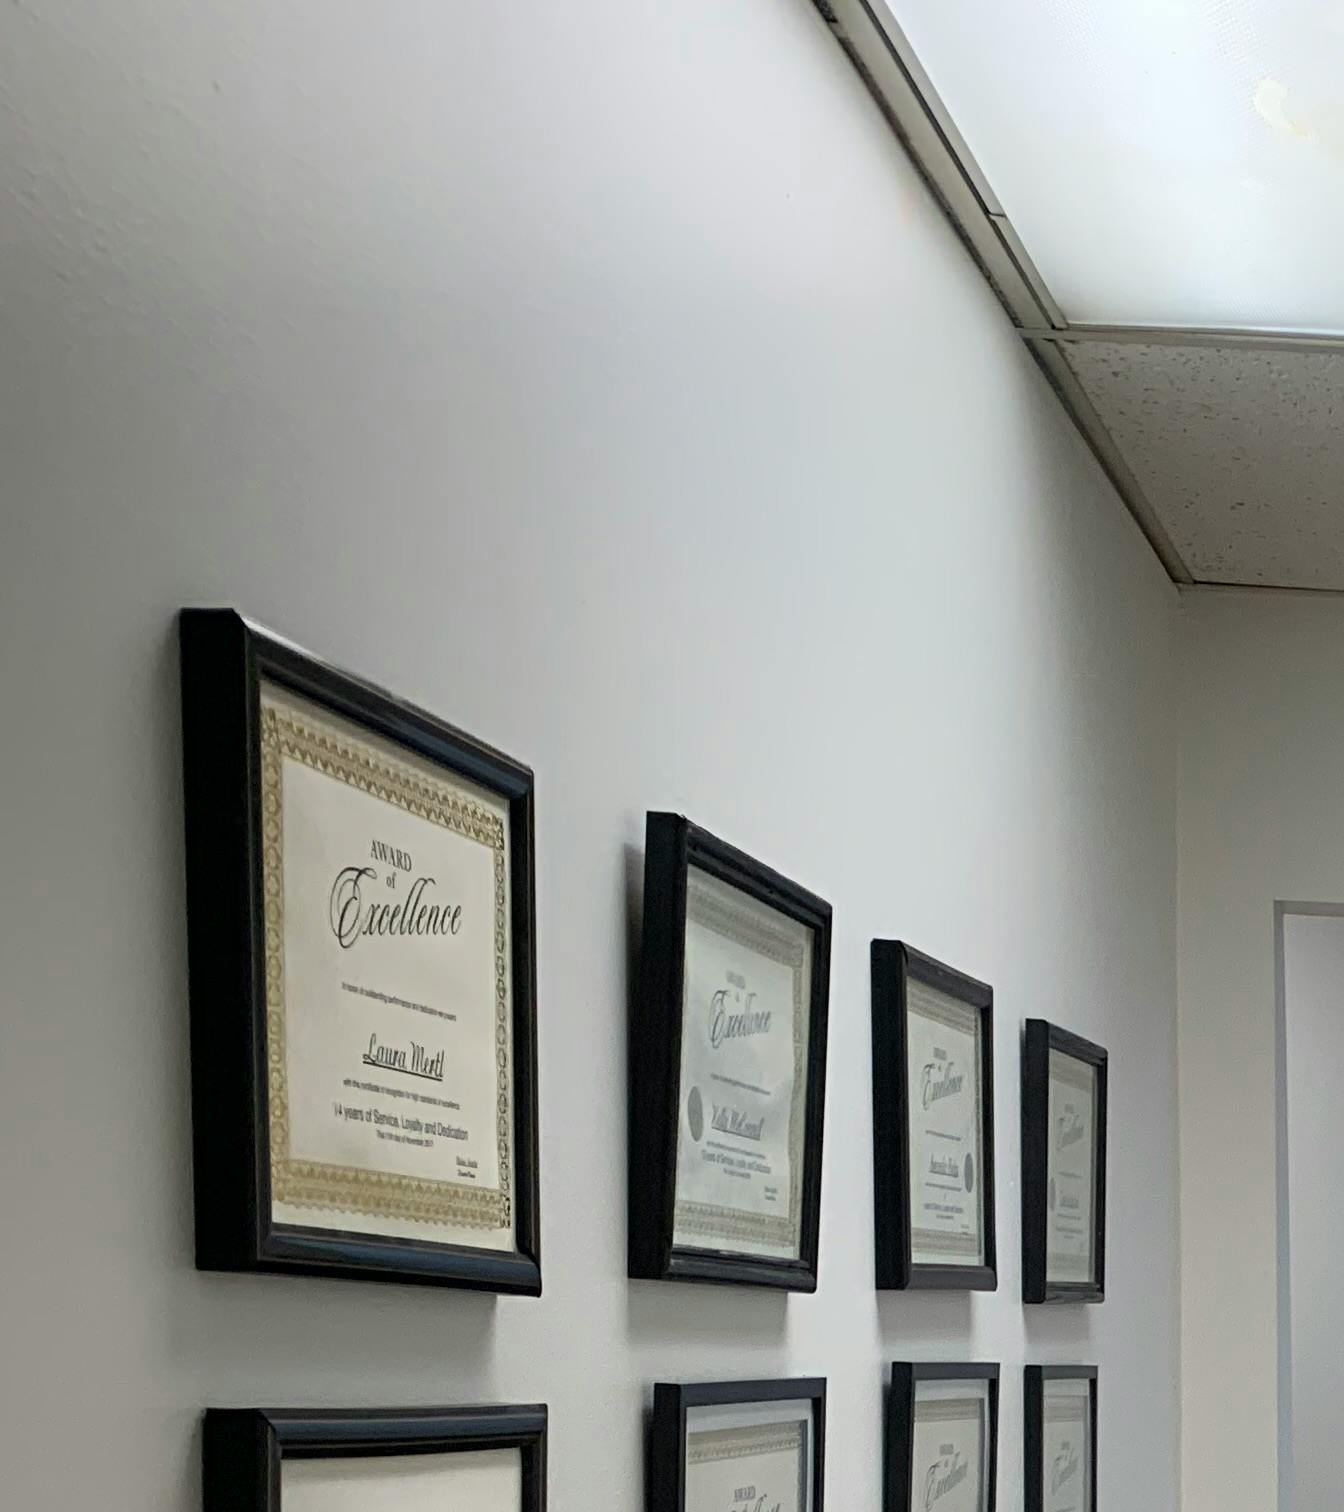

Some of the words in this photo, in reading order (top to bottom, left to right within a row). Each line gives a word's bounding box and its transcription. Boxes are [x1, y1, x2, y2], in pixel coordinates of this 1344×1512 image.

[371, 839, 412, 872] AWARD
[386, 872, 397, 889] of
[330, 867, 462, 949] Excellence
[363, 1033, 407, 1070] Laura
[410, 1041, 445, 1078] Mertl
[344, 1105, 364, 1123] years
[365, 1109, 372, 1122] of
[401, 1115, 423, 1135] Loyalty
[424, 1121, 436, 1135] and
[437, 1122, 469, 1141] Dedication
